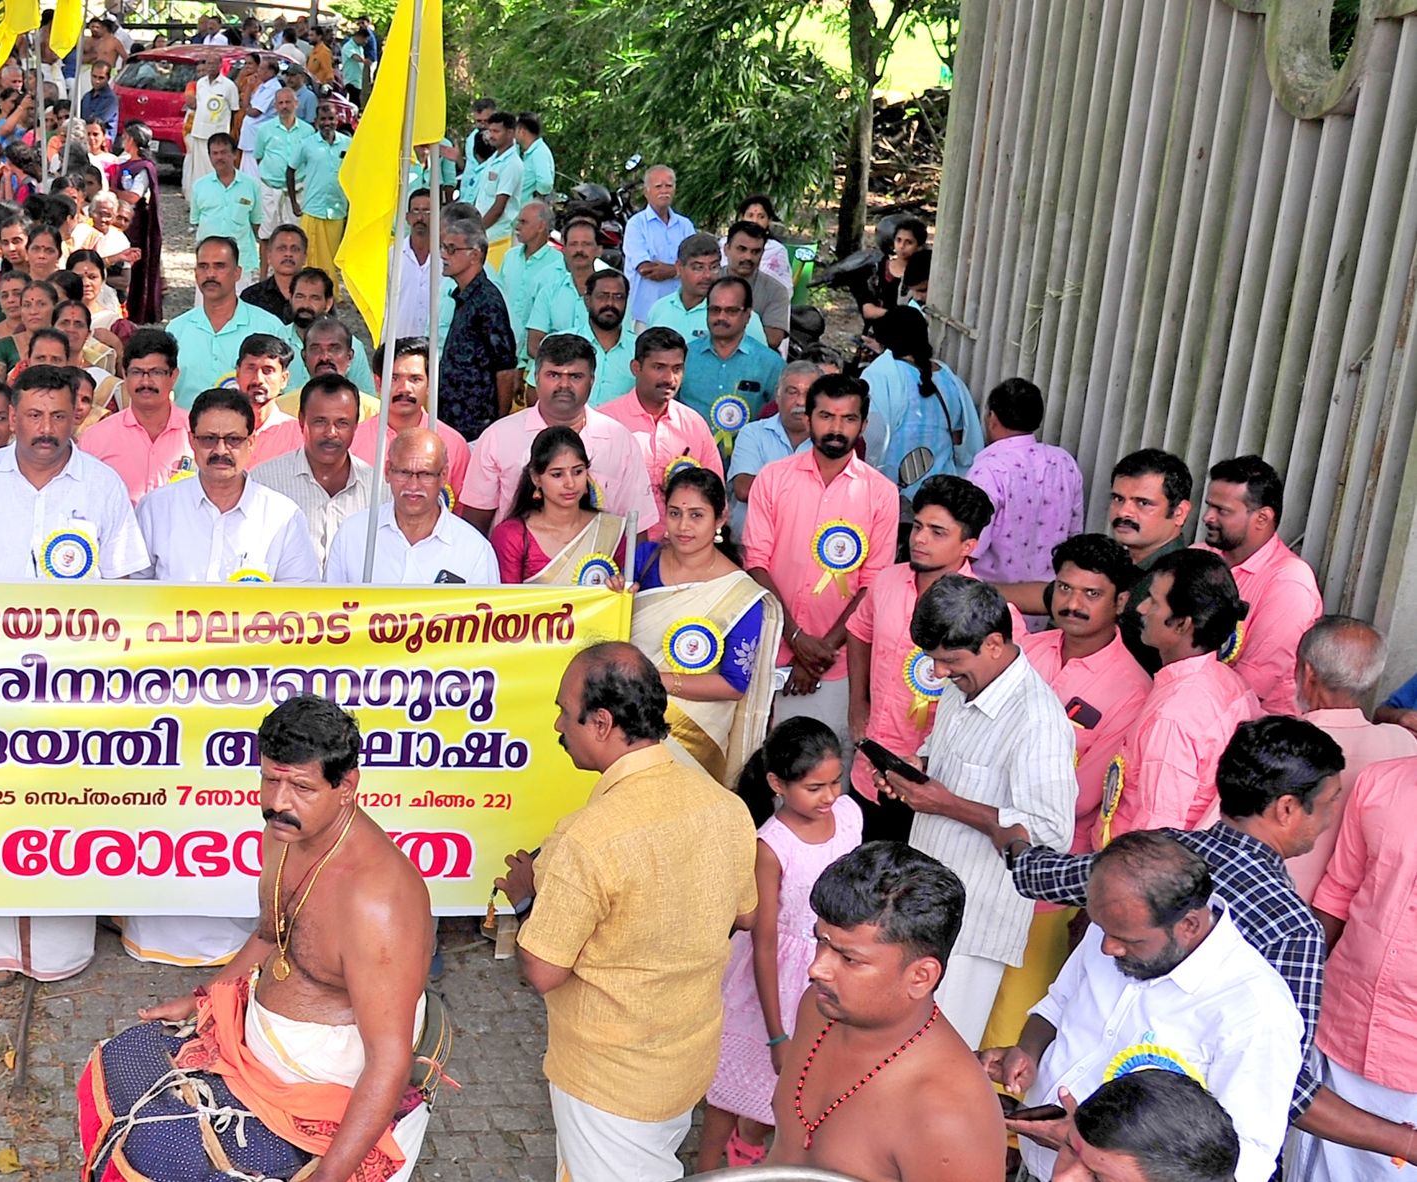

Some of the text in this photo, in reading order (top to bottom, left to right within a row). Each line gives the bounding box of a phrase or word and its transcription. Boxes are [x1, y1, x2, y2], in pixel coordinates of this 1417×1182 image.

[145, 601, 359, 644] പാലക്കാട്
[368, 602, 574, 653] യൂണിയൻ
[24, 787, 167, 806] സെപ്തംബർ
[355, 790, 401, 809] (1201
[408, 790, 476, 809] ചിങ്ങം
[483, 791, 512, 810] 22)
